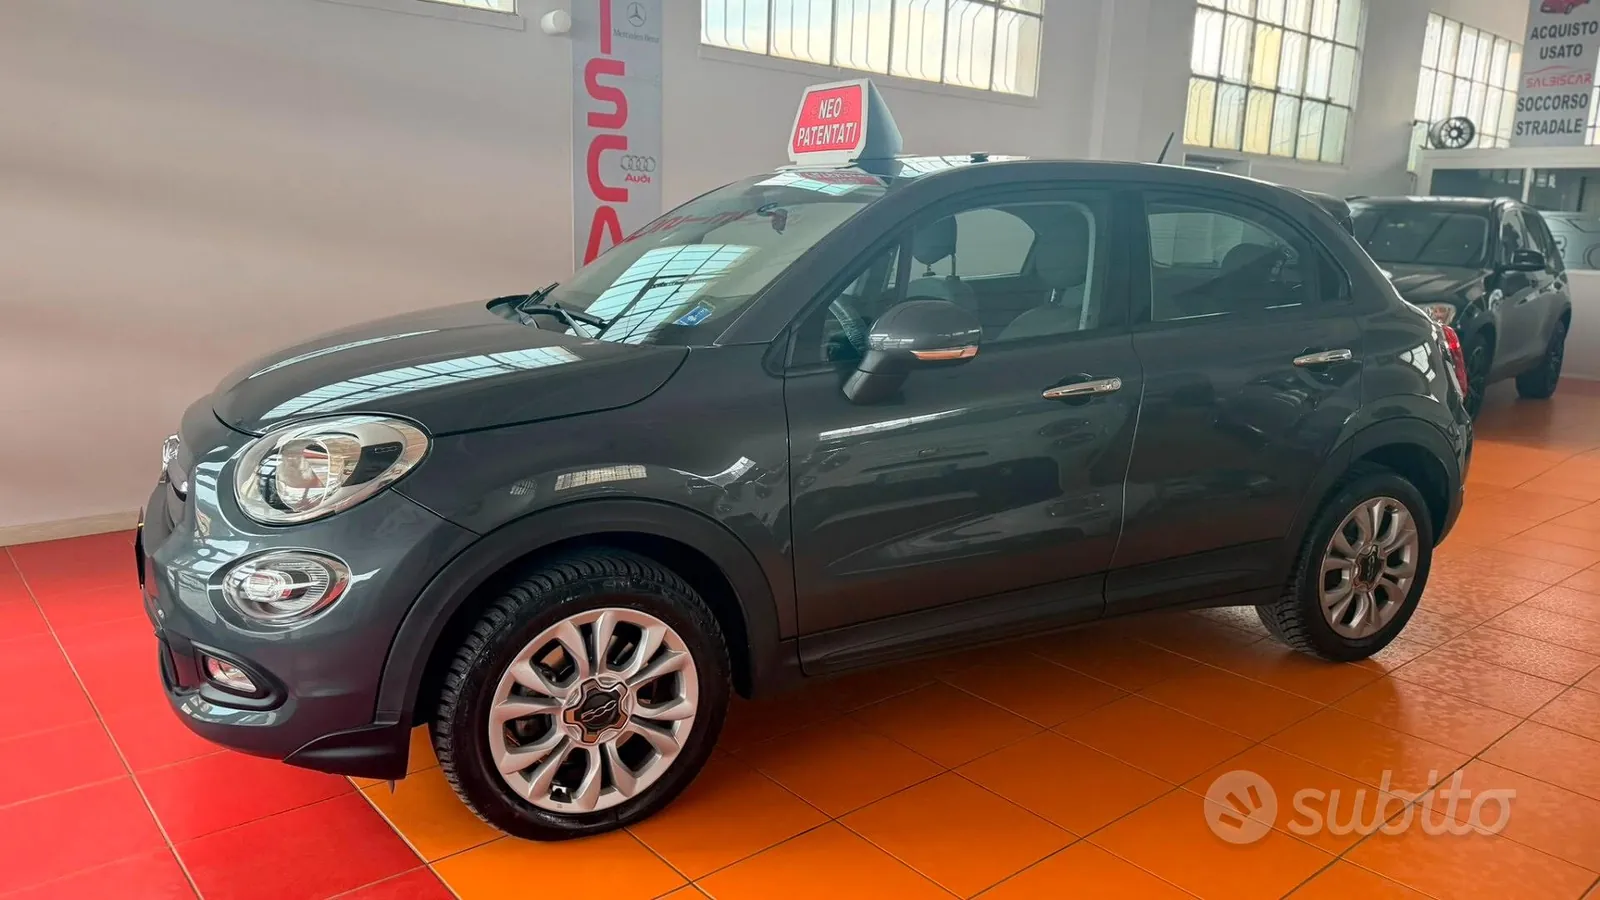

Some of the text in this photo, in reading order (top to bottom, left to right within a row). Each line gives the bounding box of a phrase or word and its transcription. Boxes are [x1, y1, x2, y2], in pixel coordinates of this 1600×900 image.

[1530, 21, 1598, 40] ACQUISTO
[1540, 43, 1583, 60] USATO
[818, 97, 842, 119] NEO
[1517, 93, 1589, 112] SOCCORSO
[797, 122, 858, 146] PATENTATI
[1516, 118, 1582, 136] STRADALE
[625, 173, 651, 184] Audi
